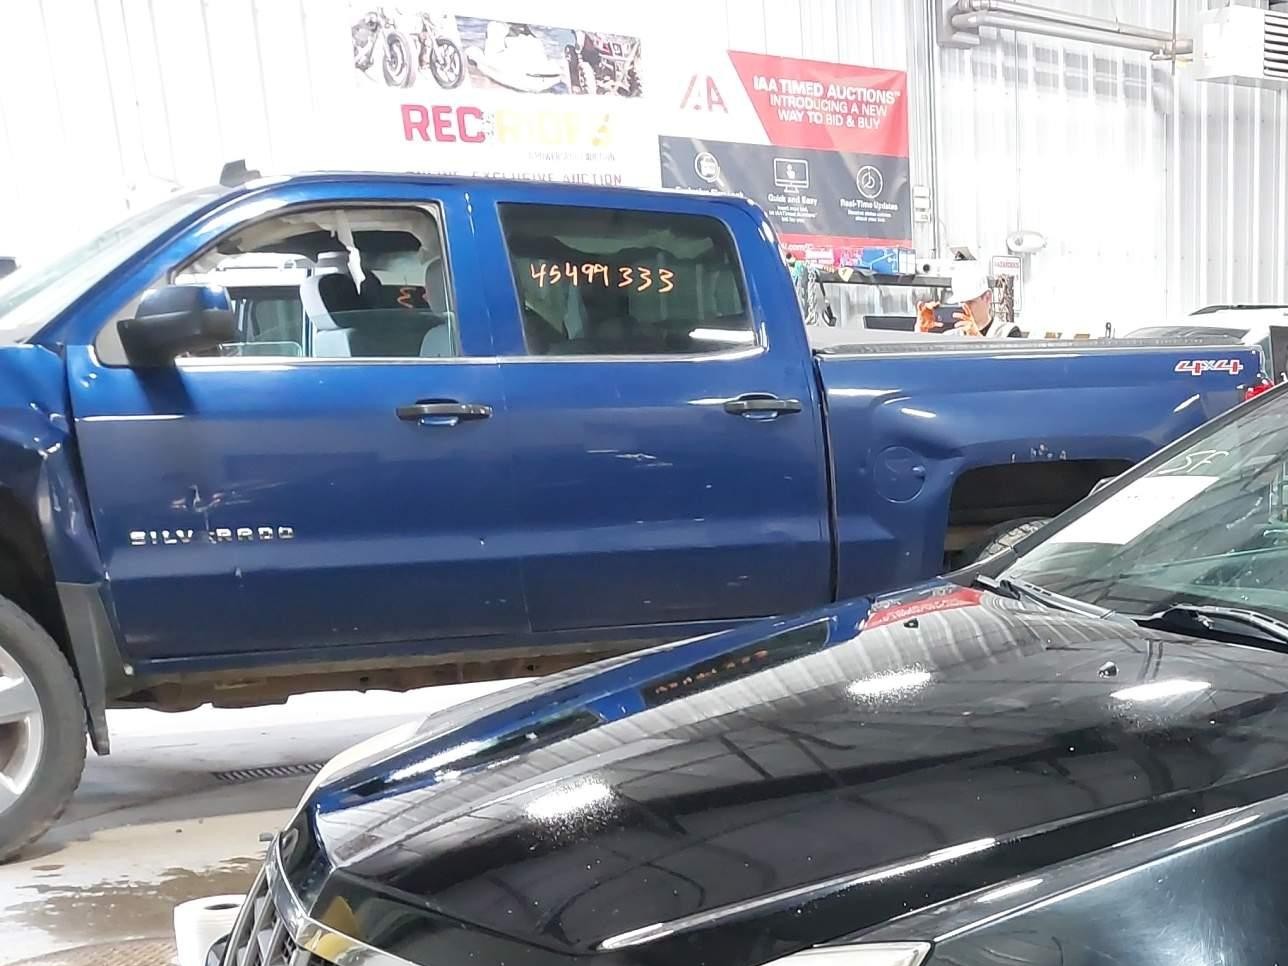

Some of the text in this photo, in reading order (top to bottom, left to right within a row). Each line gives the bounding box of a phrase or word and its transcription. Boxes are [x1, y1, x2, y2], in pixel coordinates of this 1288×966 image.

[753, 76, 778, 92] IAA
[779, 79, 823, 97] TIMED
[770, 94, 887, 117] INTRODUCING A NEW
[778, 109, 880, 129] WAY TO BID & BUY
[129, 526, 294, 546] SILVRADO
